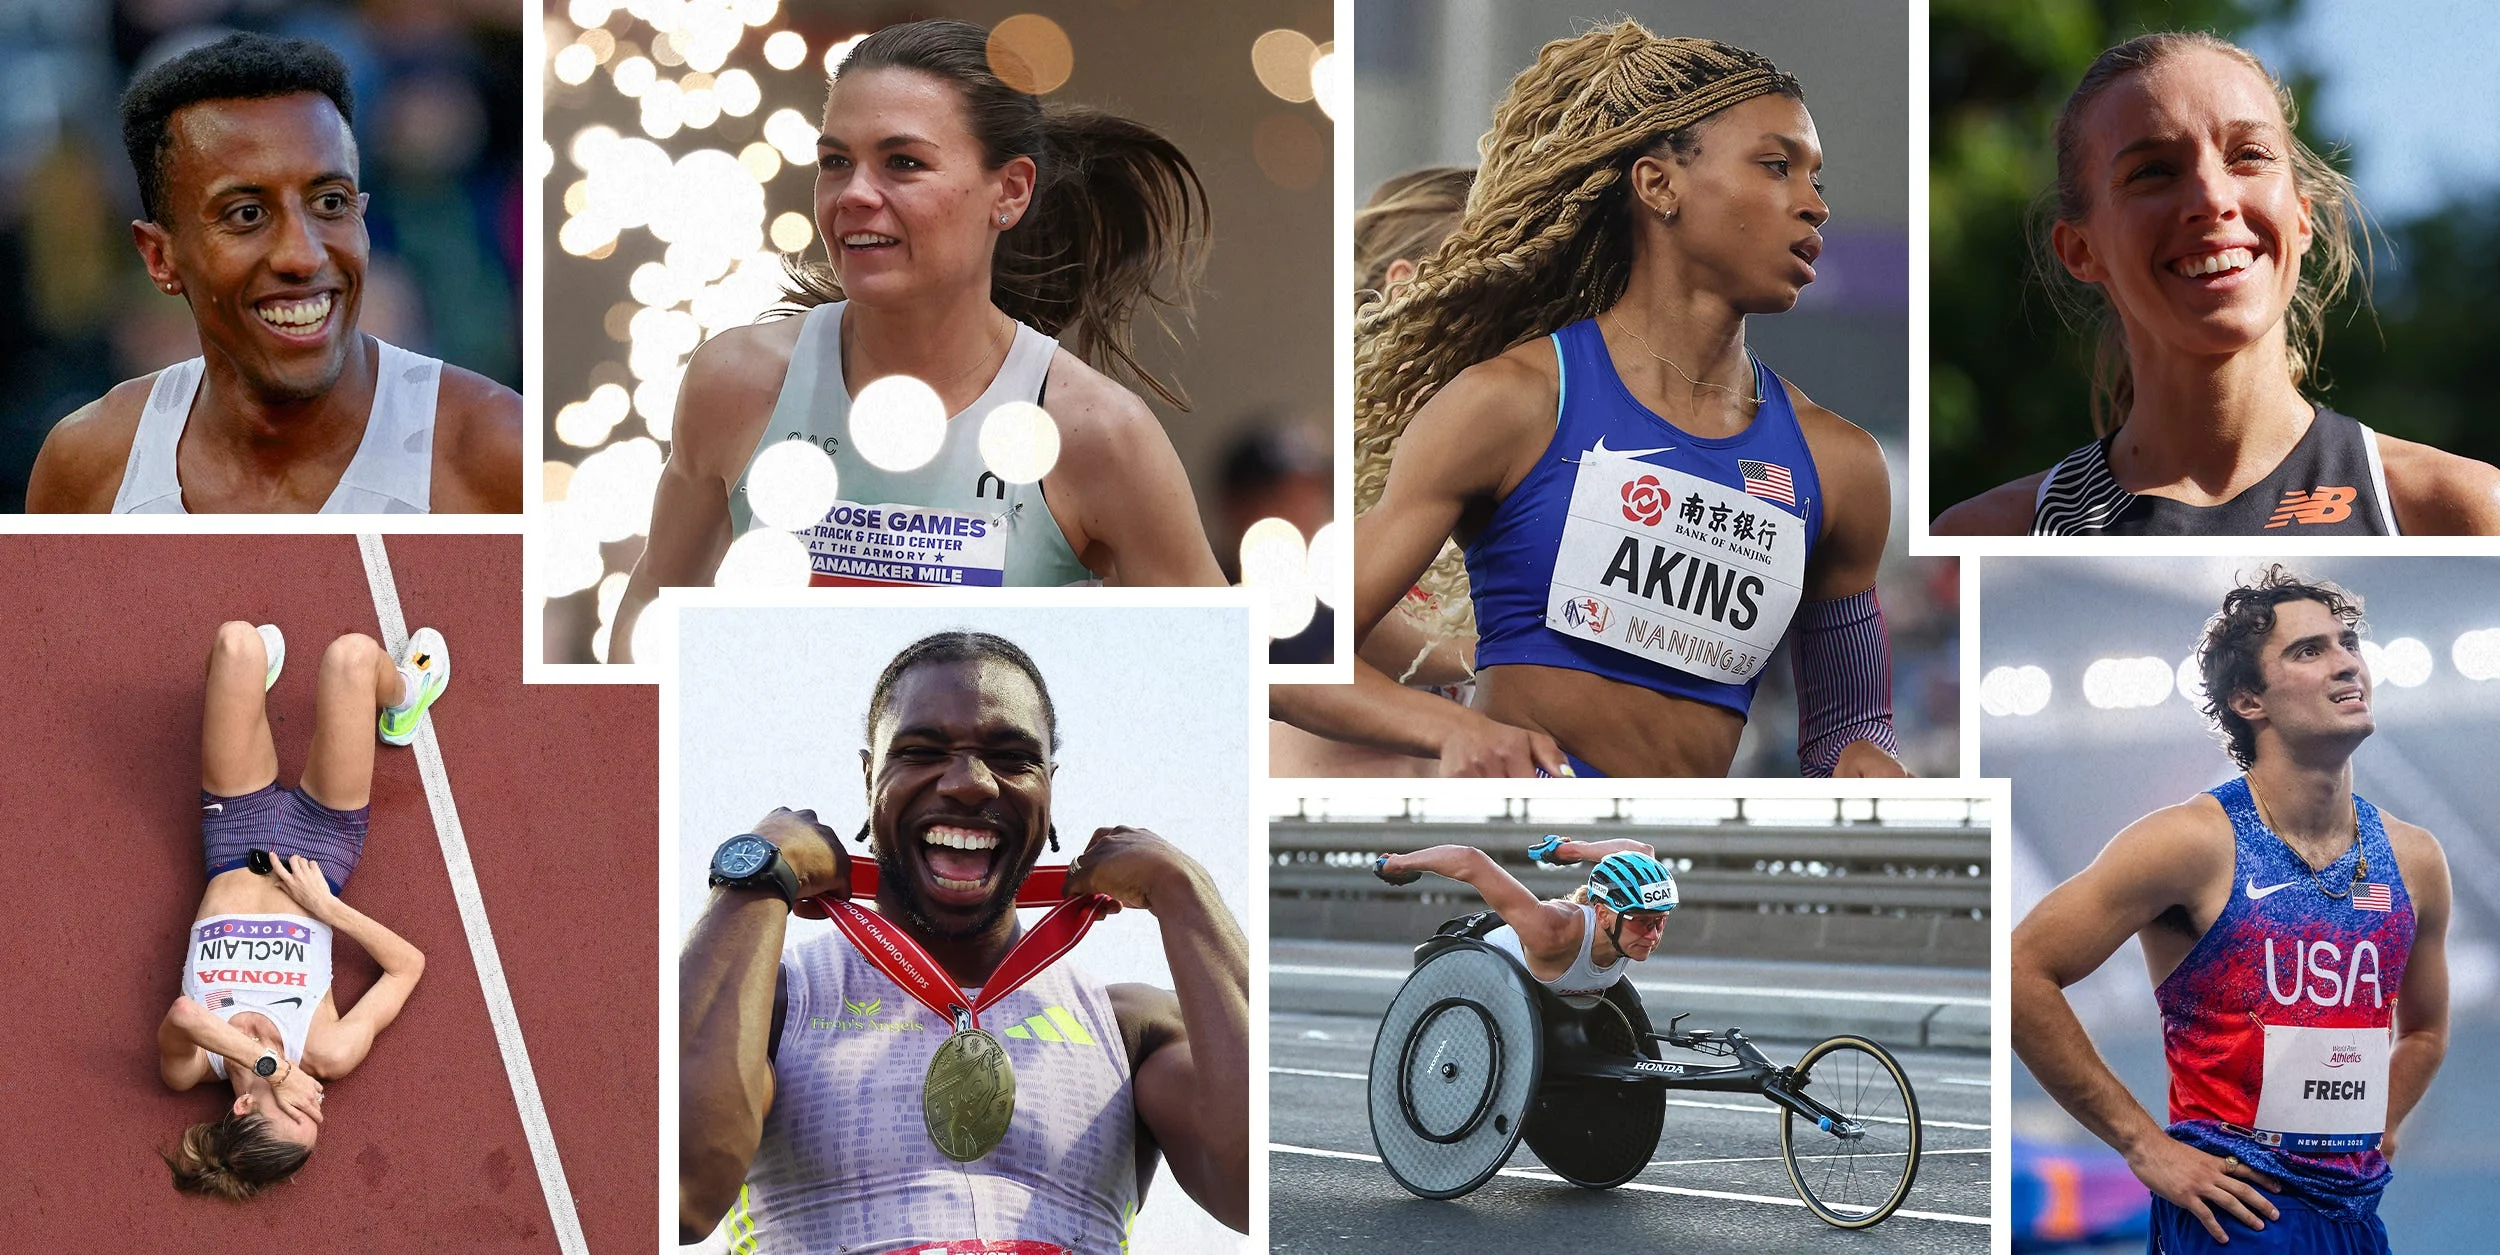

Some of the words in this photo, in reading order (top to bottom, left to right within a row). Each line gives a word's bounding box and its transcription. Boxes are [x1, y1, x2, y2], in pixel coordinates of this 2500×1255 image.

[887, 512, 986, 538] GAMES
[814, 525, 853, 541] TRACK
[855, 530, 864, 543] &
[867, 532, 905, 547] FIELD
[908, 536, 963, 551] CENTER
[1675, 524, 1708, 543] BANK
[1711, 536, 1726, 548] OF
[1728, 542, 1772, 565] NANJING
[809, 540, 824, 551] AT
[831, 542, 856, 555] THE
[863, 547, 926, 561] ARMORY
[918, 566, 963, 583] MILE
[1600, 535, 1765, 631] AKINS
[200, 939, 304, 962] McCLAIN
[867, 923, 930, 989] CHAMPIONSHIPS
[196, 969, 309, 987] HONDA
[2265, 938, 2382, 1009] USA
[1633, 1060, 1685, 1075] HONDA
[2330, 1051, 2362, 1064] Athletics
[2303, 1080, 2366, 1101] FRECH
[2297, 1139, 2318, 1147] NEW
[2321, 1139, 2345, 1147] DELHI
[2347, 1139, 2364, 1147] 2025
